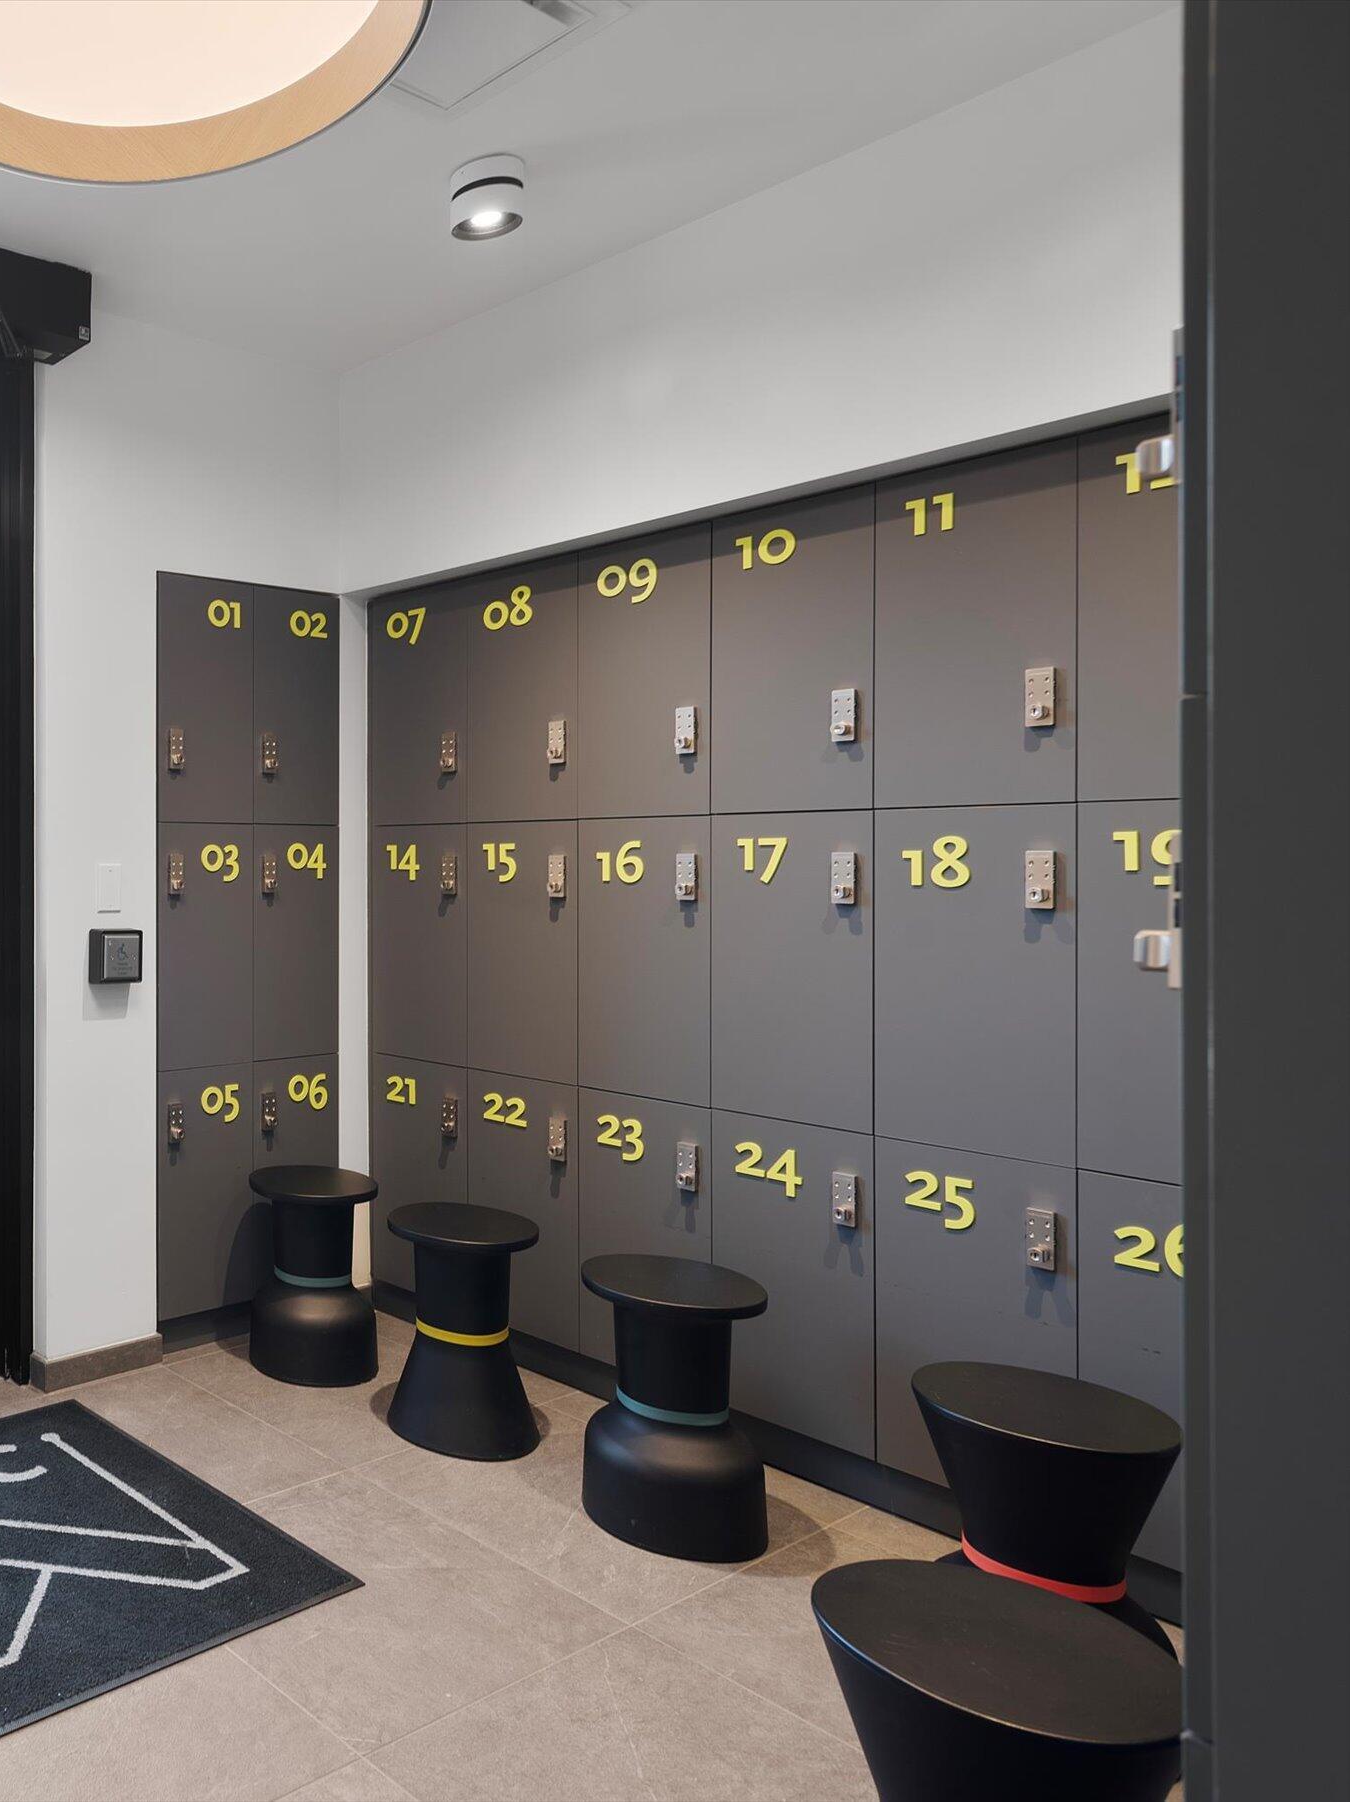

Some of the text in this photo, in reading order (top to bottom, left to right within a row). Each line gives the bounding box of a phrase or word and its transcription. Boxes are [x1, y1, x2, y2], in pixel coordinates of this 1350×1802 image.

[1115, 452, 1176, 496] 1
[905, 492, 955, 537] 11
[735, 528, 797, 570] 10
[597, 558, 659, 604] 09
[207, 599, 242, 629] 01
[289, 610, 329, 639] 02
[385, 607, 427, 645] 07
[482, 585, 534, 631] 08
[200, 843, 241, 883] 03
[286, 842, 328, 880] 04
[385, 844, 421, 882] 14
[482, 842, 518, 884] 15
[596, 838, 646, 885] 16
[735, 836, 790, 884] 17
[902, 835, 972, 889] 18
[200, 1083, 241, 1123] 05
[287, 1072, 329, 1111] 06
[385, 1075, 417, 1106] 21
[482, 1092, 529, 1129] 22
[596, 1113, 645, 1163] 23
[734, 1141, 804, 1199] 24
[904, 1170, 977, 1231] 25
